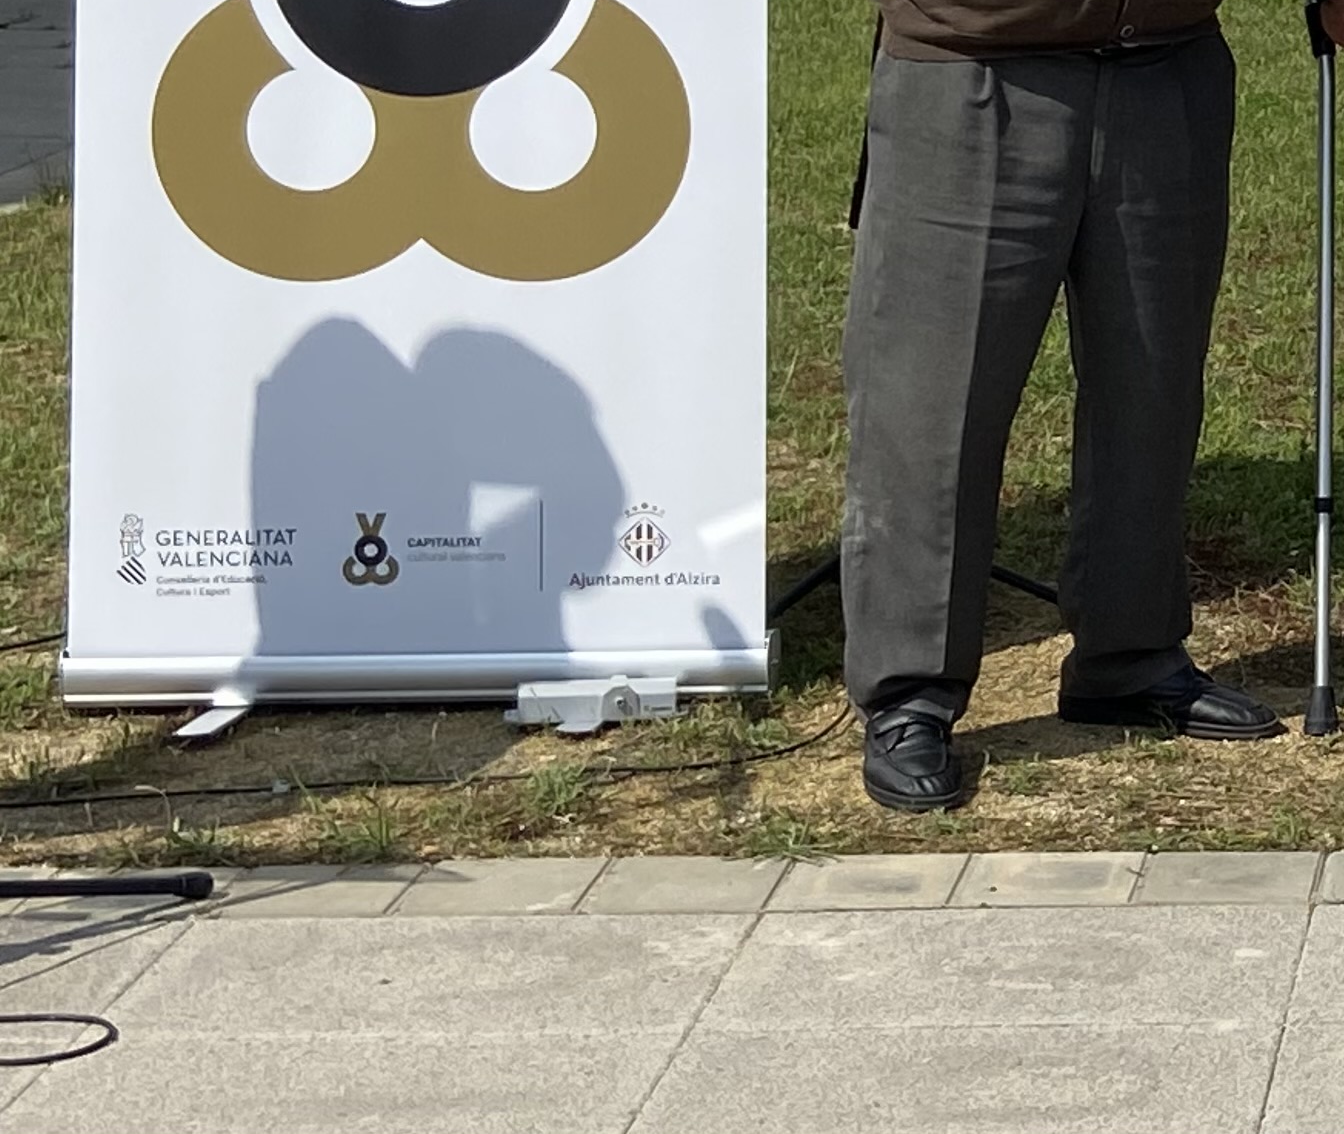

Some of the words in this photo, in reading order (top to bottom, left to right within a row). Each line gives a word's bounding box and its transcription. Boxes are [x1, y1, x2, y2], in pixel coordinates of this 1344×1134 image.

[155, 528, 297, 547] GENERALITAT
[407, 537, 482, 548] CAPITALITAT
[156, 550, 293, 567] VALENCIANA
[569, 572, 661, 590] Ajuntament
[664, 571, 721, 585] d'Alzira
